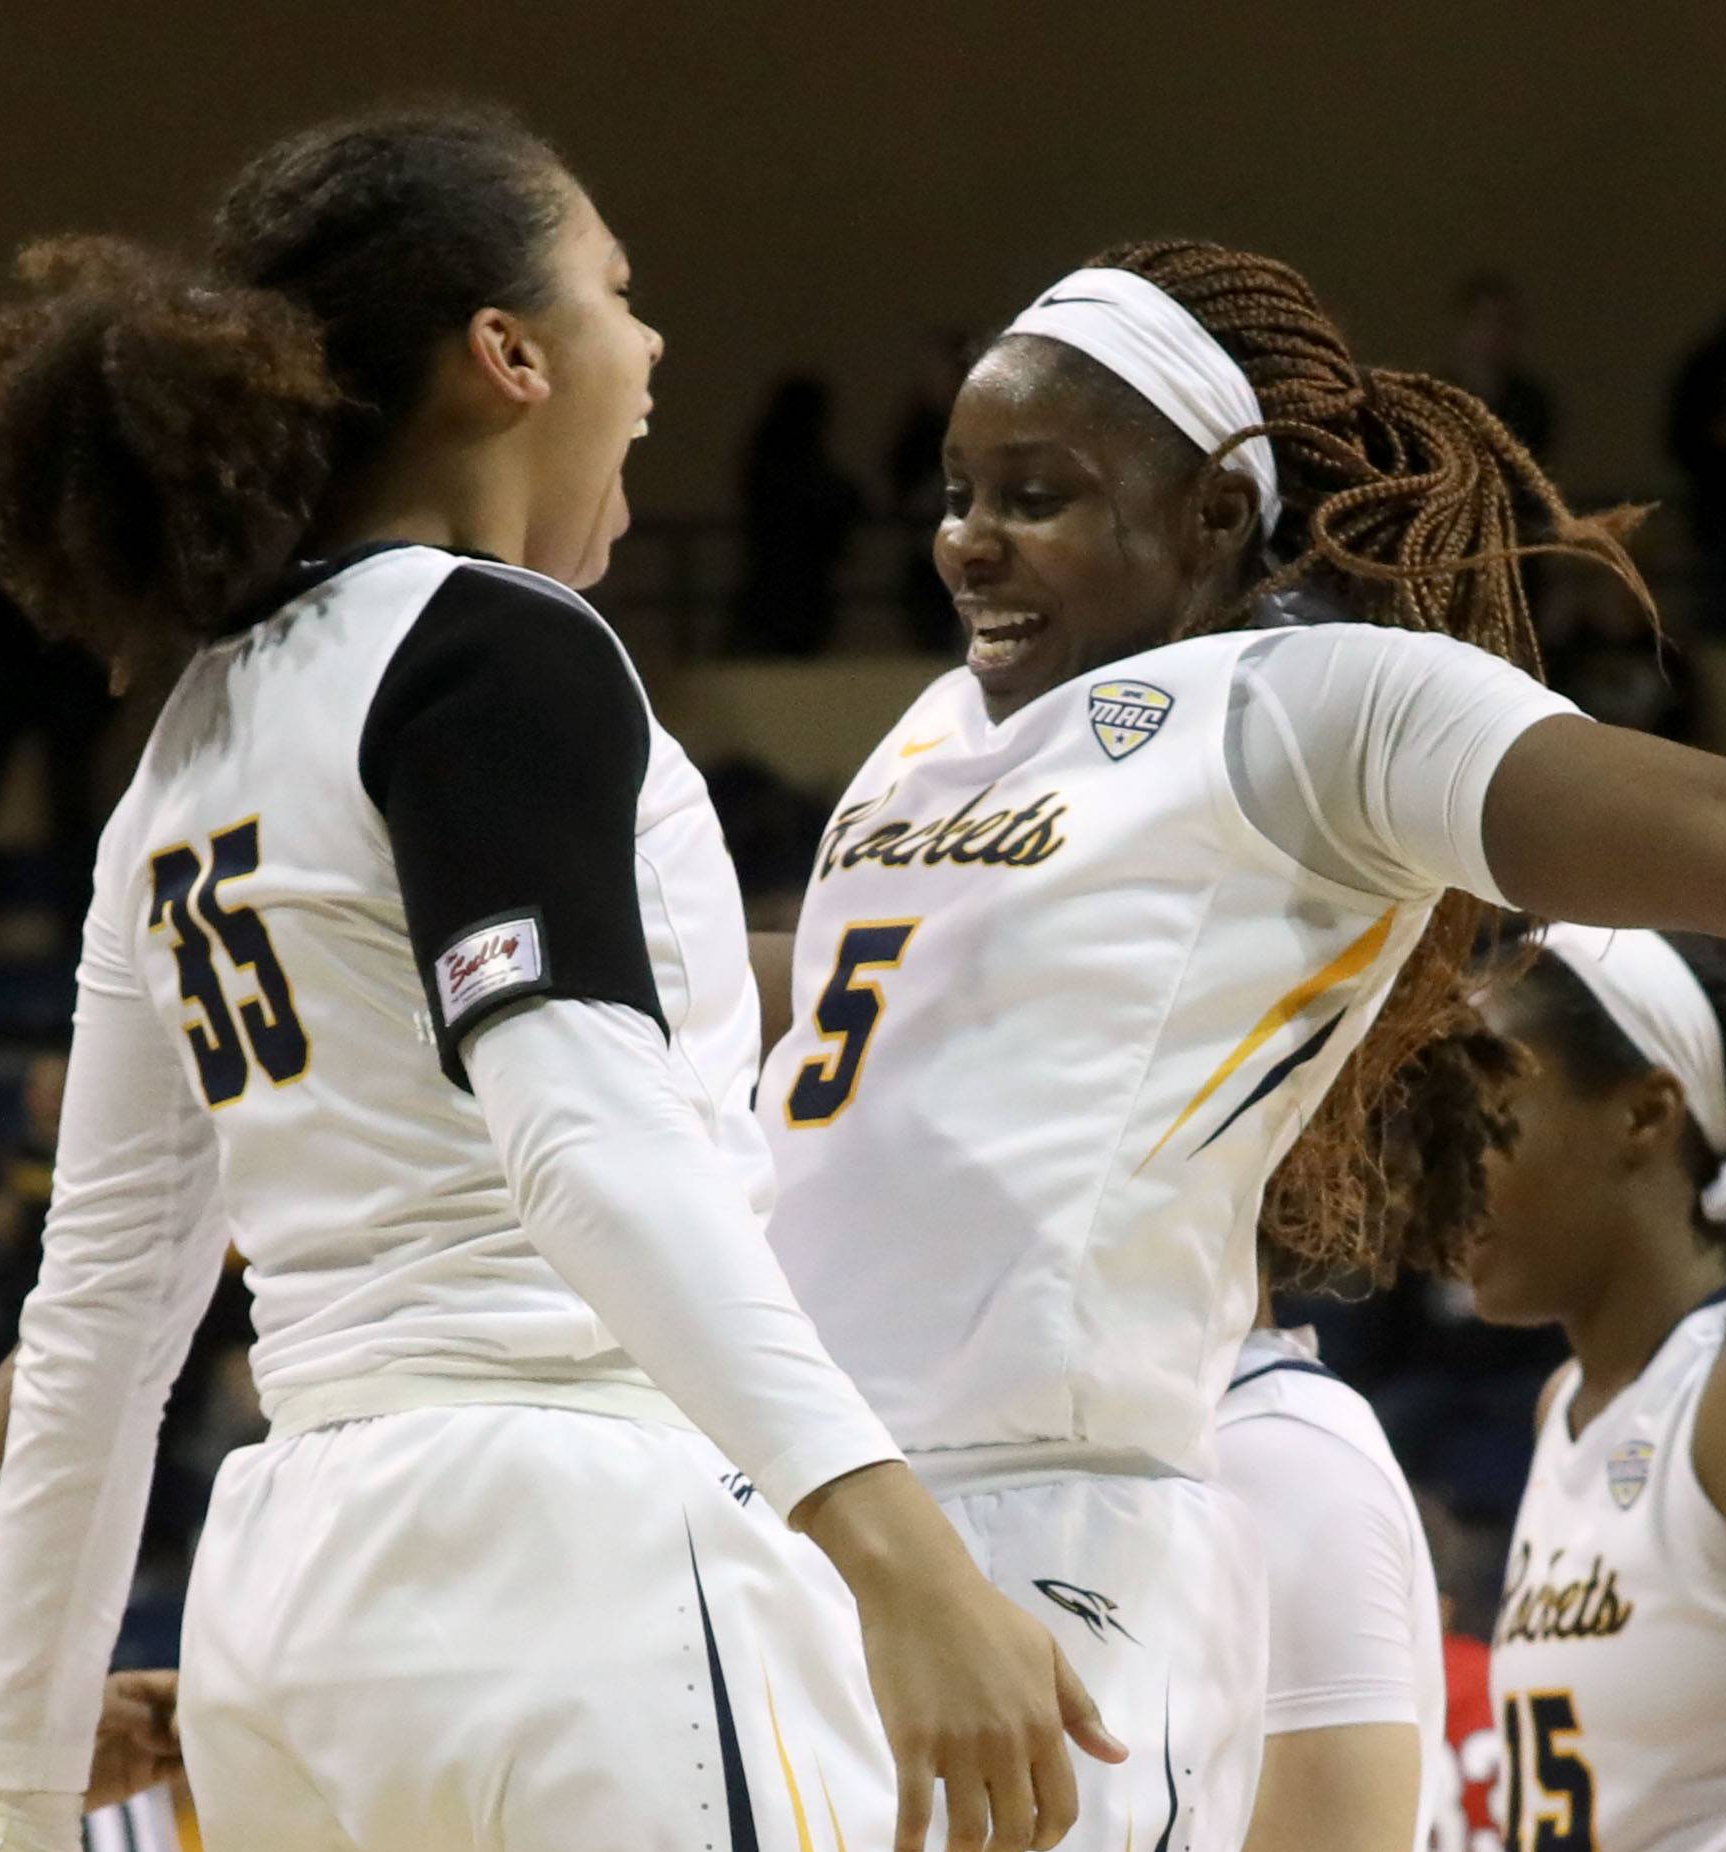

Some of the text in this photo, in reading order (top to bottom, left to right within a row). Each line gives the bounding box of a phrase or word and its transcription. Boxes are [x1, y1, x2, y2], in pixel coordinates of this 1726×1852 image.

[1089, 699, 1164, 730] MAC
[149, 813, 312, 1112] 35
[784, 916, 925, 1130] 5
